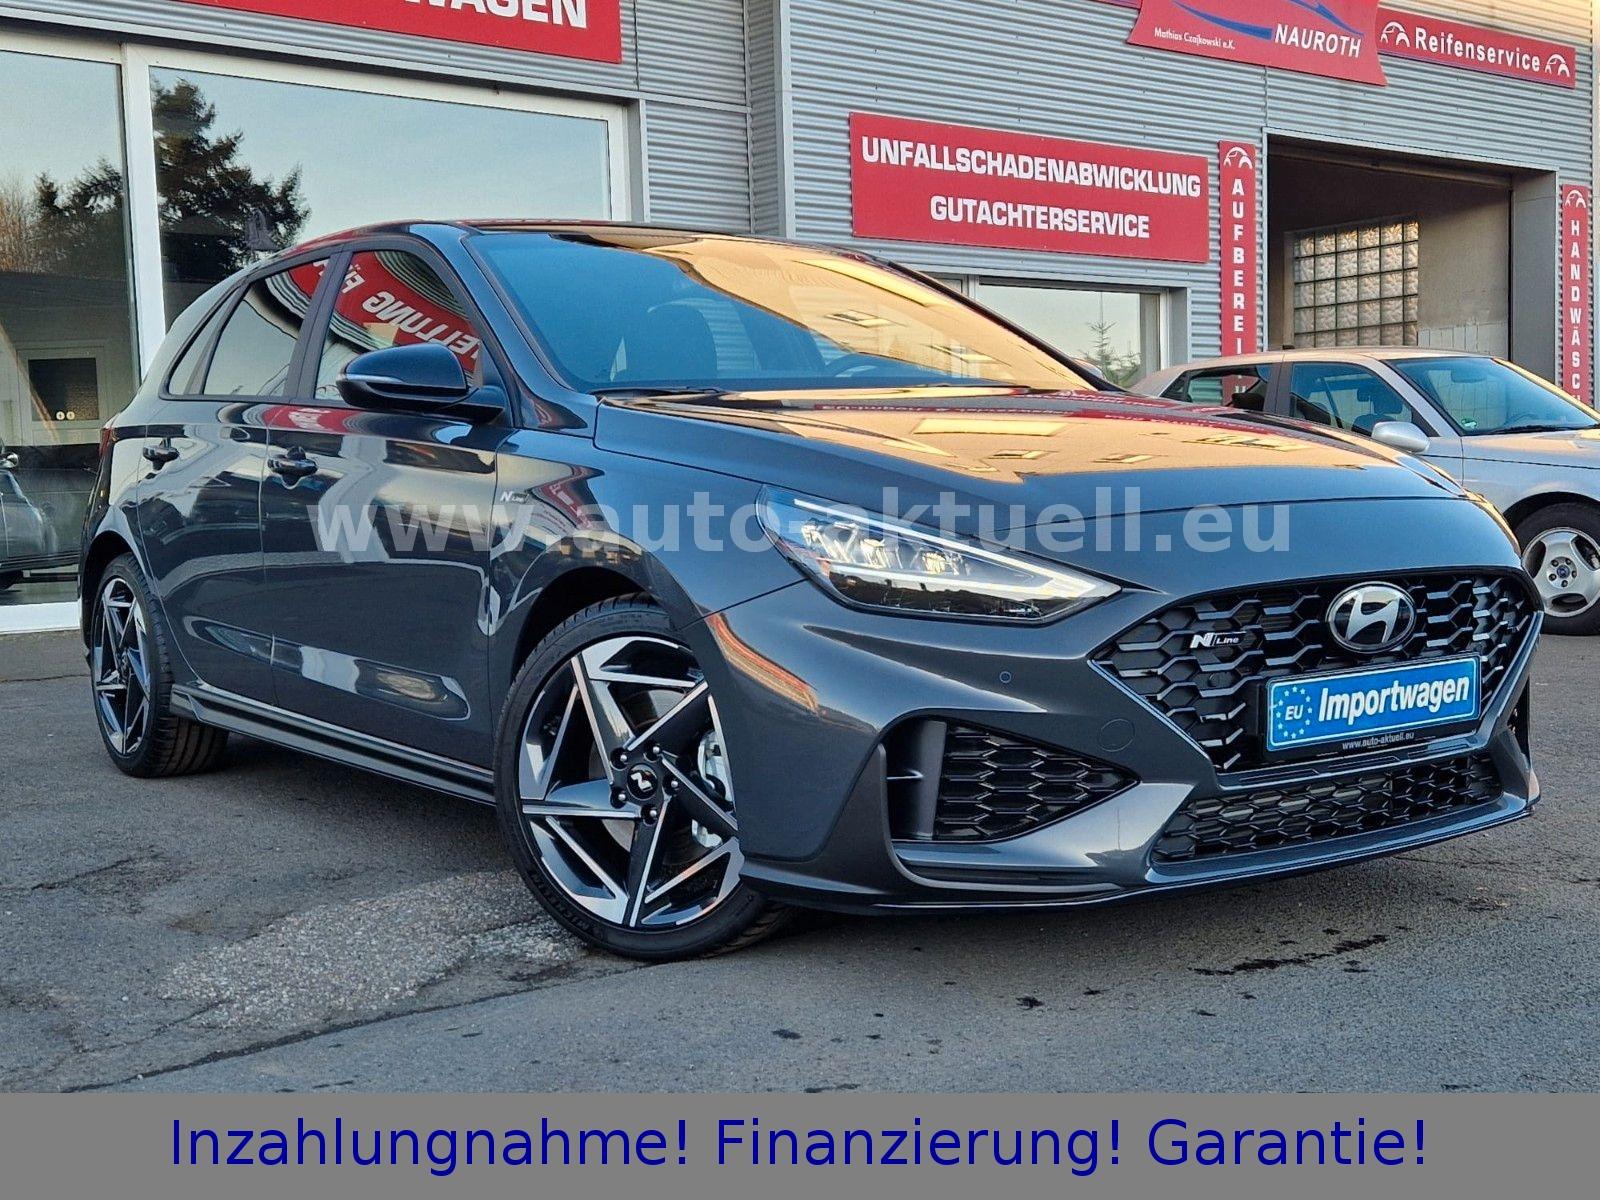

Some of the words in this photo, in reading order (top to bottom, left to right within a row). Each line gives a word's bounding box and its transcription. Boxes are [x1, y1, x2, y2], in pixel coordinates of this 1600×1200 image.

[1154, 26, 1182, 41] Mathias
[1274, 23, 1362, 58] NAUROTH
[1415, 26, 1540, 72] Reifenservice
[861, 135, 1201, 198] UNFALLSCHADENABWICKLUNG
[930, 195, 1150, 240] GUTACHTERSERVICE
[1231, 178, 1246, 394] AUFBEREI
[1284, 704, 1304, 721] EU
[1318, 676, 1470, 726] Importwagen
[1342, 731, 1415, 750] www.auto-aktuell.eu
